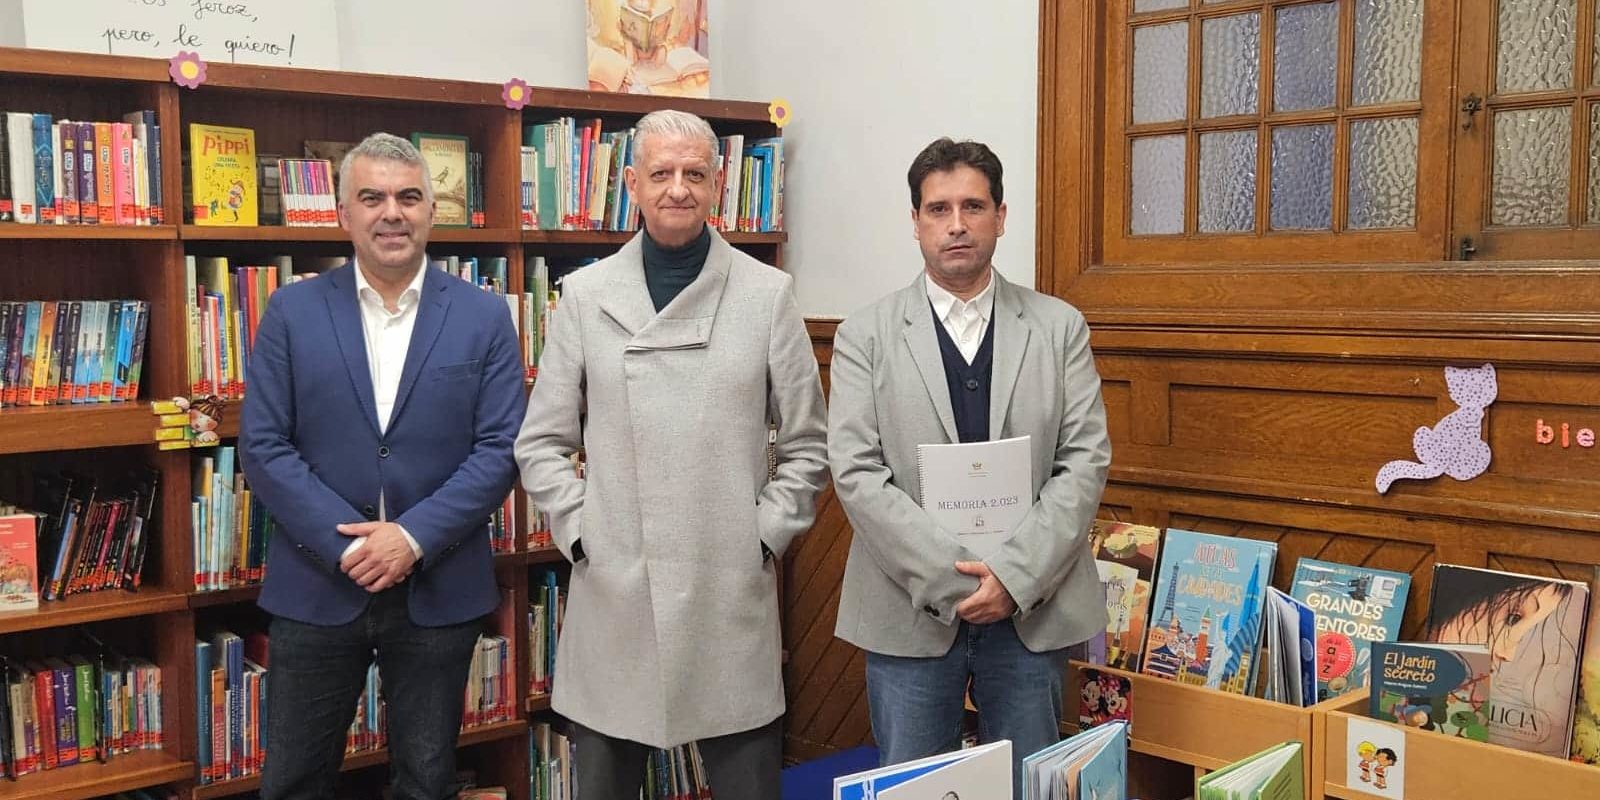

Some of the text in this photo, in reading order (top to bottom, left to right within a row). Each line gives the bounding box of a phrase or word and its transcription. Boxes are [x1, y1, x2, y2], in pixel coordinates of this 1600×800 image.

[102, 24, 295, 65] pero, le quiero!
[1536, 418, 1595, 448] bie
[938, 496, 1018, 510] MEMORIA 2.023
[1306, 592, 1384, 621] GRANDES
[1316, 614, 1387, 641] ENTORES
[1384, 652, 1398, 665] El
[1384, 667, 1436, 683] secreto
[1490, 705, 1537, 732] LICIA
